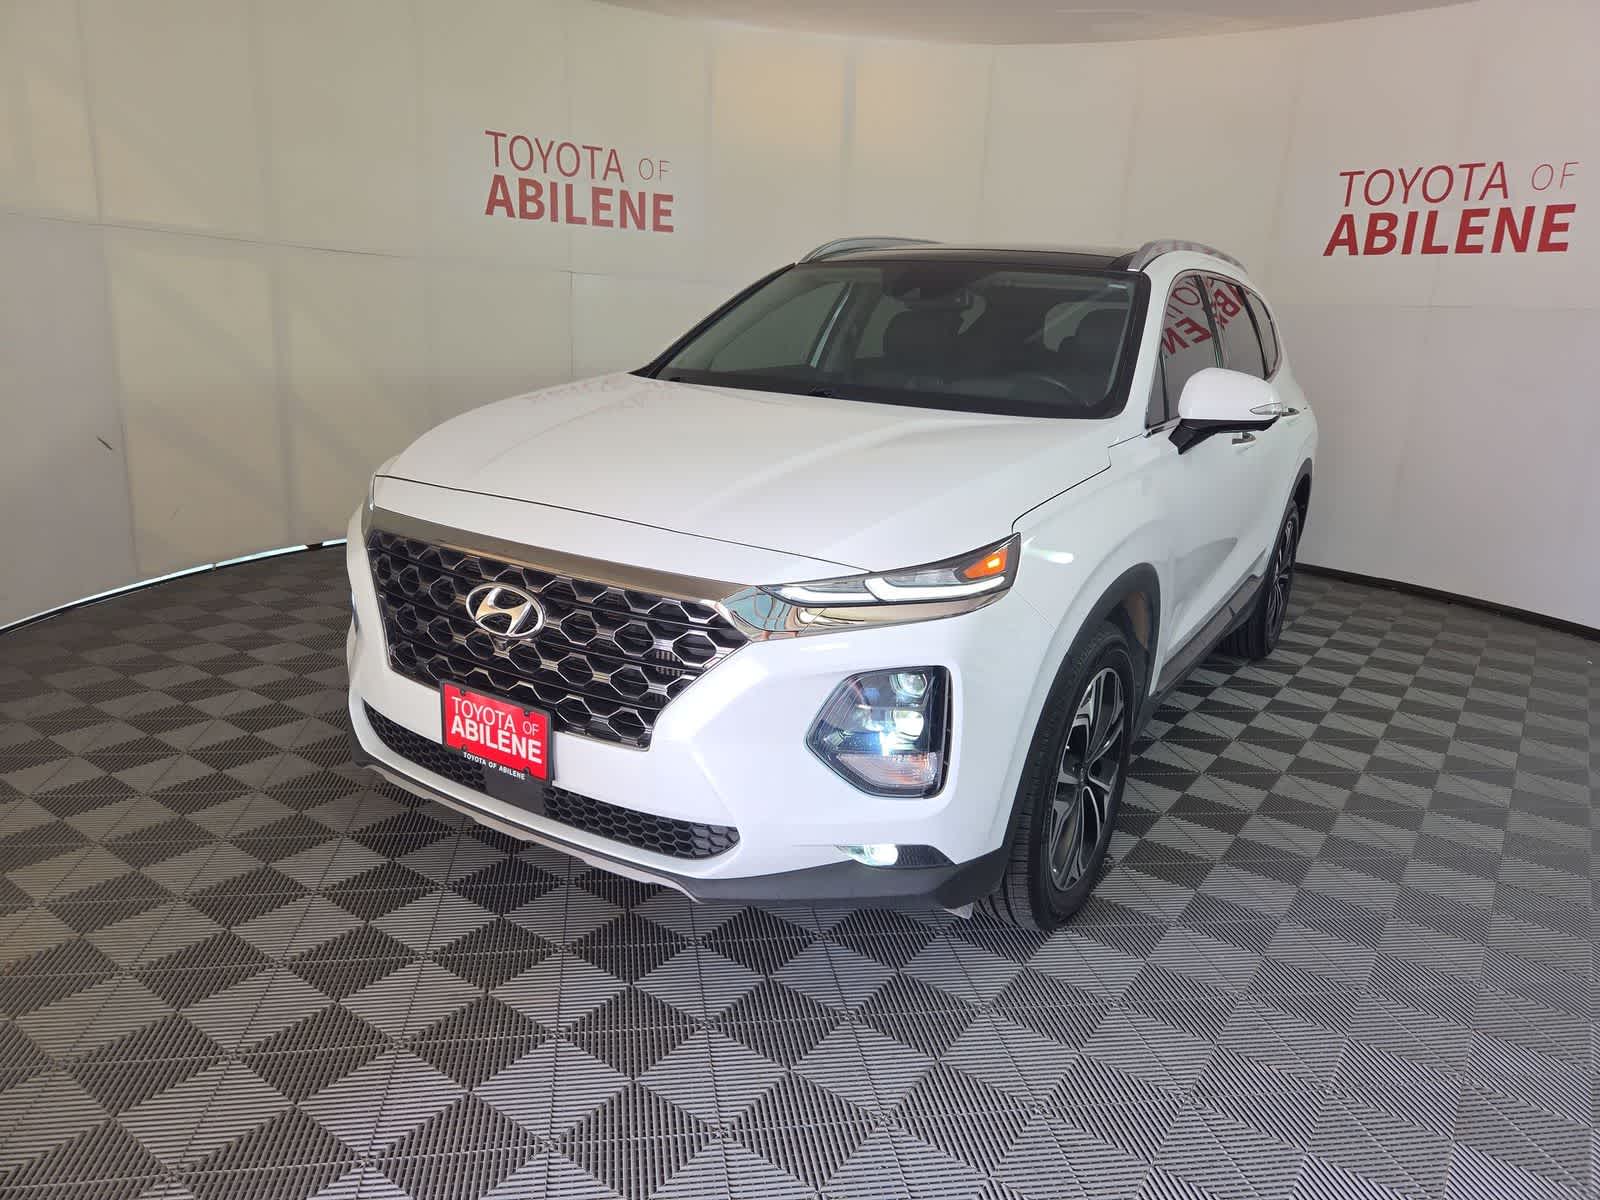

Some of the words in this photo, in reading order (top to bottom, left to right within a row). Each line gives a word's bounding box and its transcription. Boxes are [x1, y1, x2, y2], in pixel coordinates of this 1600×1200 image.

[485, 129, 625, 183] TOYOTA
[638, 158, 671, 182] OF
[484, 173, 675, 233] ABILENE
[1339, 161, 1509, 208] TOYOTA
[1531, 161, 1580, 191] OF
[1322, 203, 1577, 256] ABILENE
[450, 714, 543, 765] ABILENE
[451, 696, 516, 734] TOYOTA
[522, 720, 540, 736] OF
[463, 751, 487, 766] TOYOTA
[488, 761, 497, 769] OF
[498, 765, 526, 780] ABILENE
